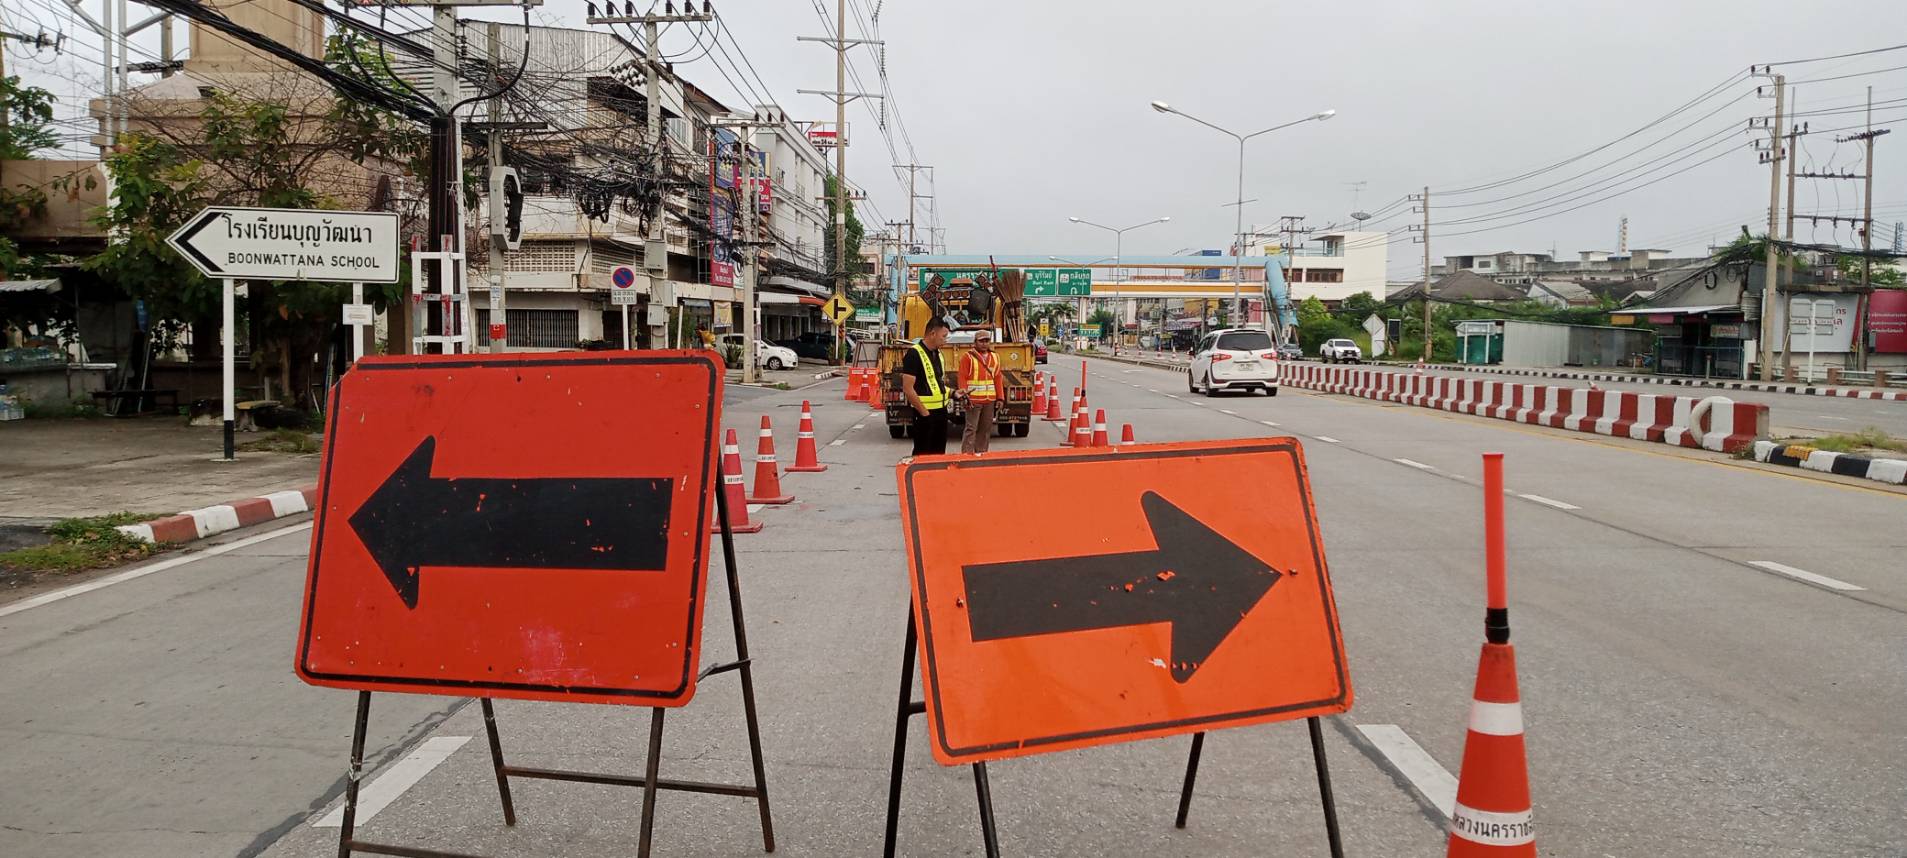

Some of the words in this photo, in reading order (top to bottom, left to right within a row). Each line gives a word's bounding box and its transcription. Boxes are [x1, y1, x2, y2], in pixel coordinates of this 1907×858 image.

[221, 213, 372, 248] โรงเรียนบุญวัฒนา
[228, 252, 325, 267] BOONWATTANA
[331, 255, 380, 269] SCHOOL
